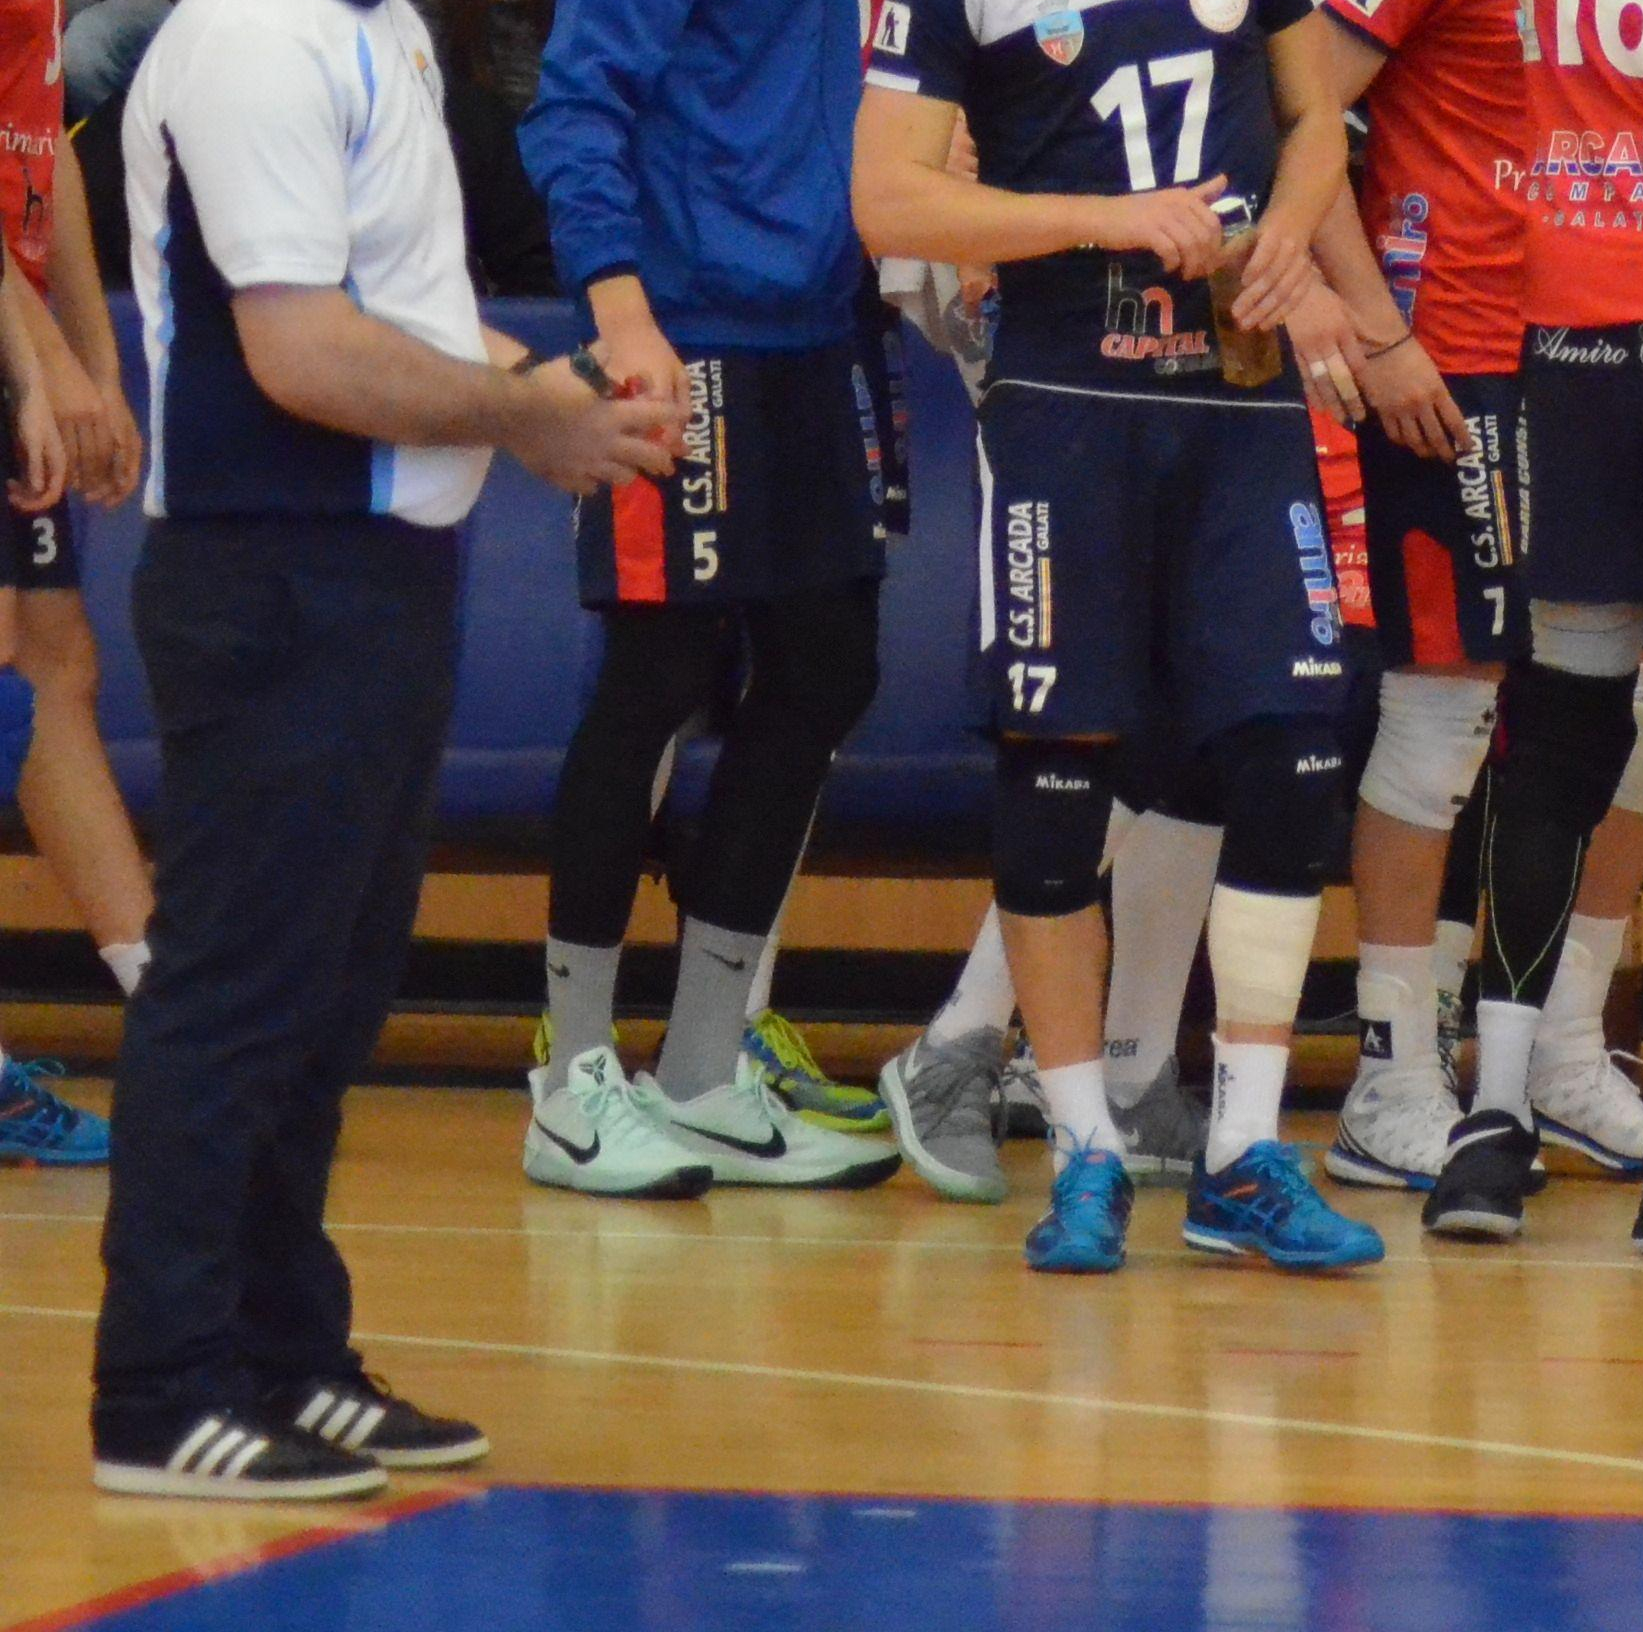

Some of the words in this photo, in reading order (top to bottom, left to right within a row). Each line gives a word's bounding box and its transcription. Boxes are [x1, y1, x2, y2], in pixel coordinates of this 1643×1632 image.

[1089, 49, 1215, 192] 17
[1534, 326, 1630, 366] Amiro
[32, 517, 57, 565] 3
[692, 531, 719, 581] 5
[1008, 501, 1034, 597] ARCADA
[1007, 661, 1057, 714] 17
